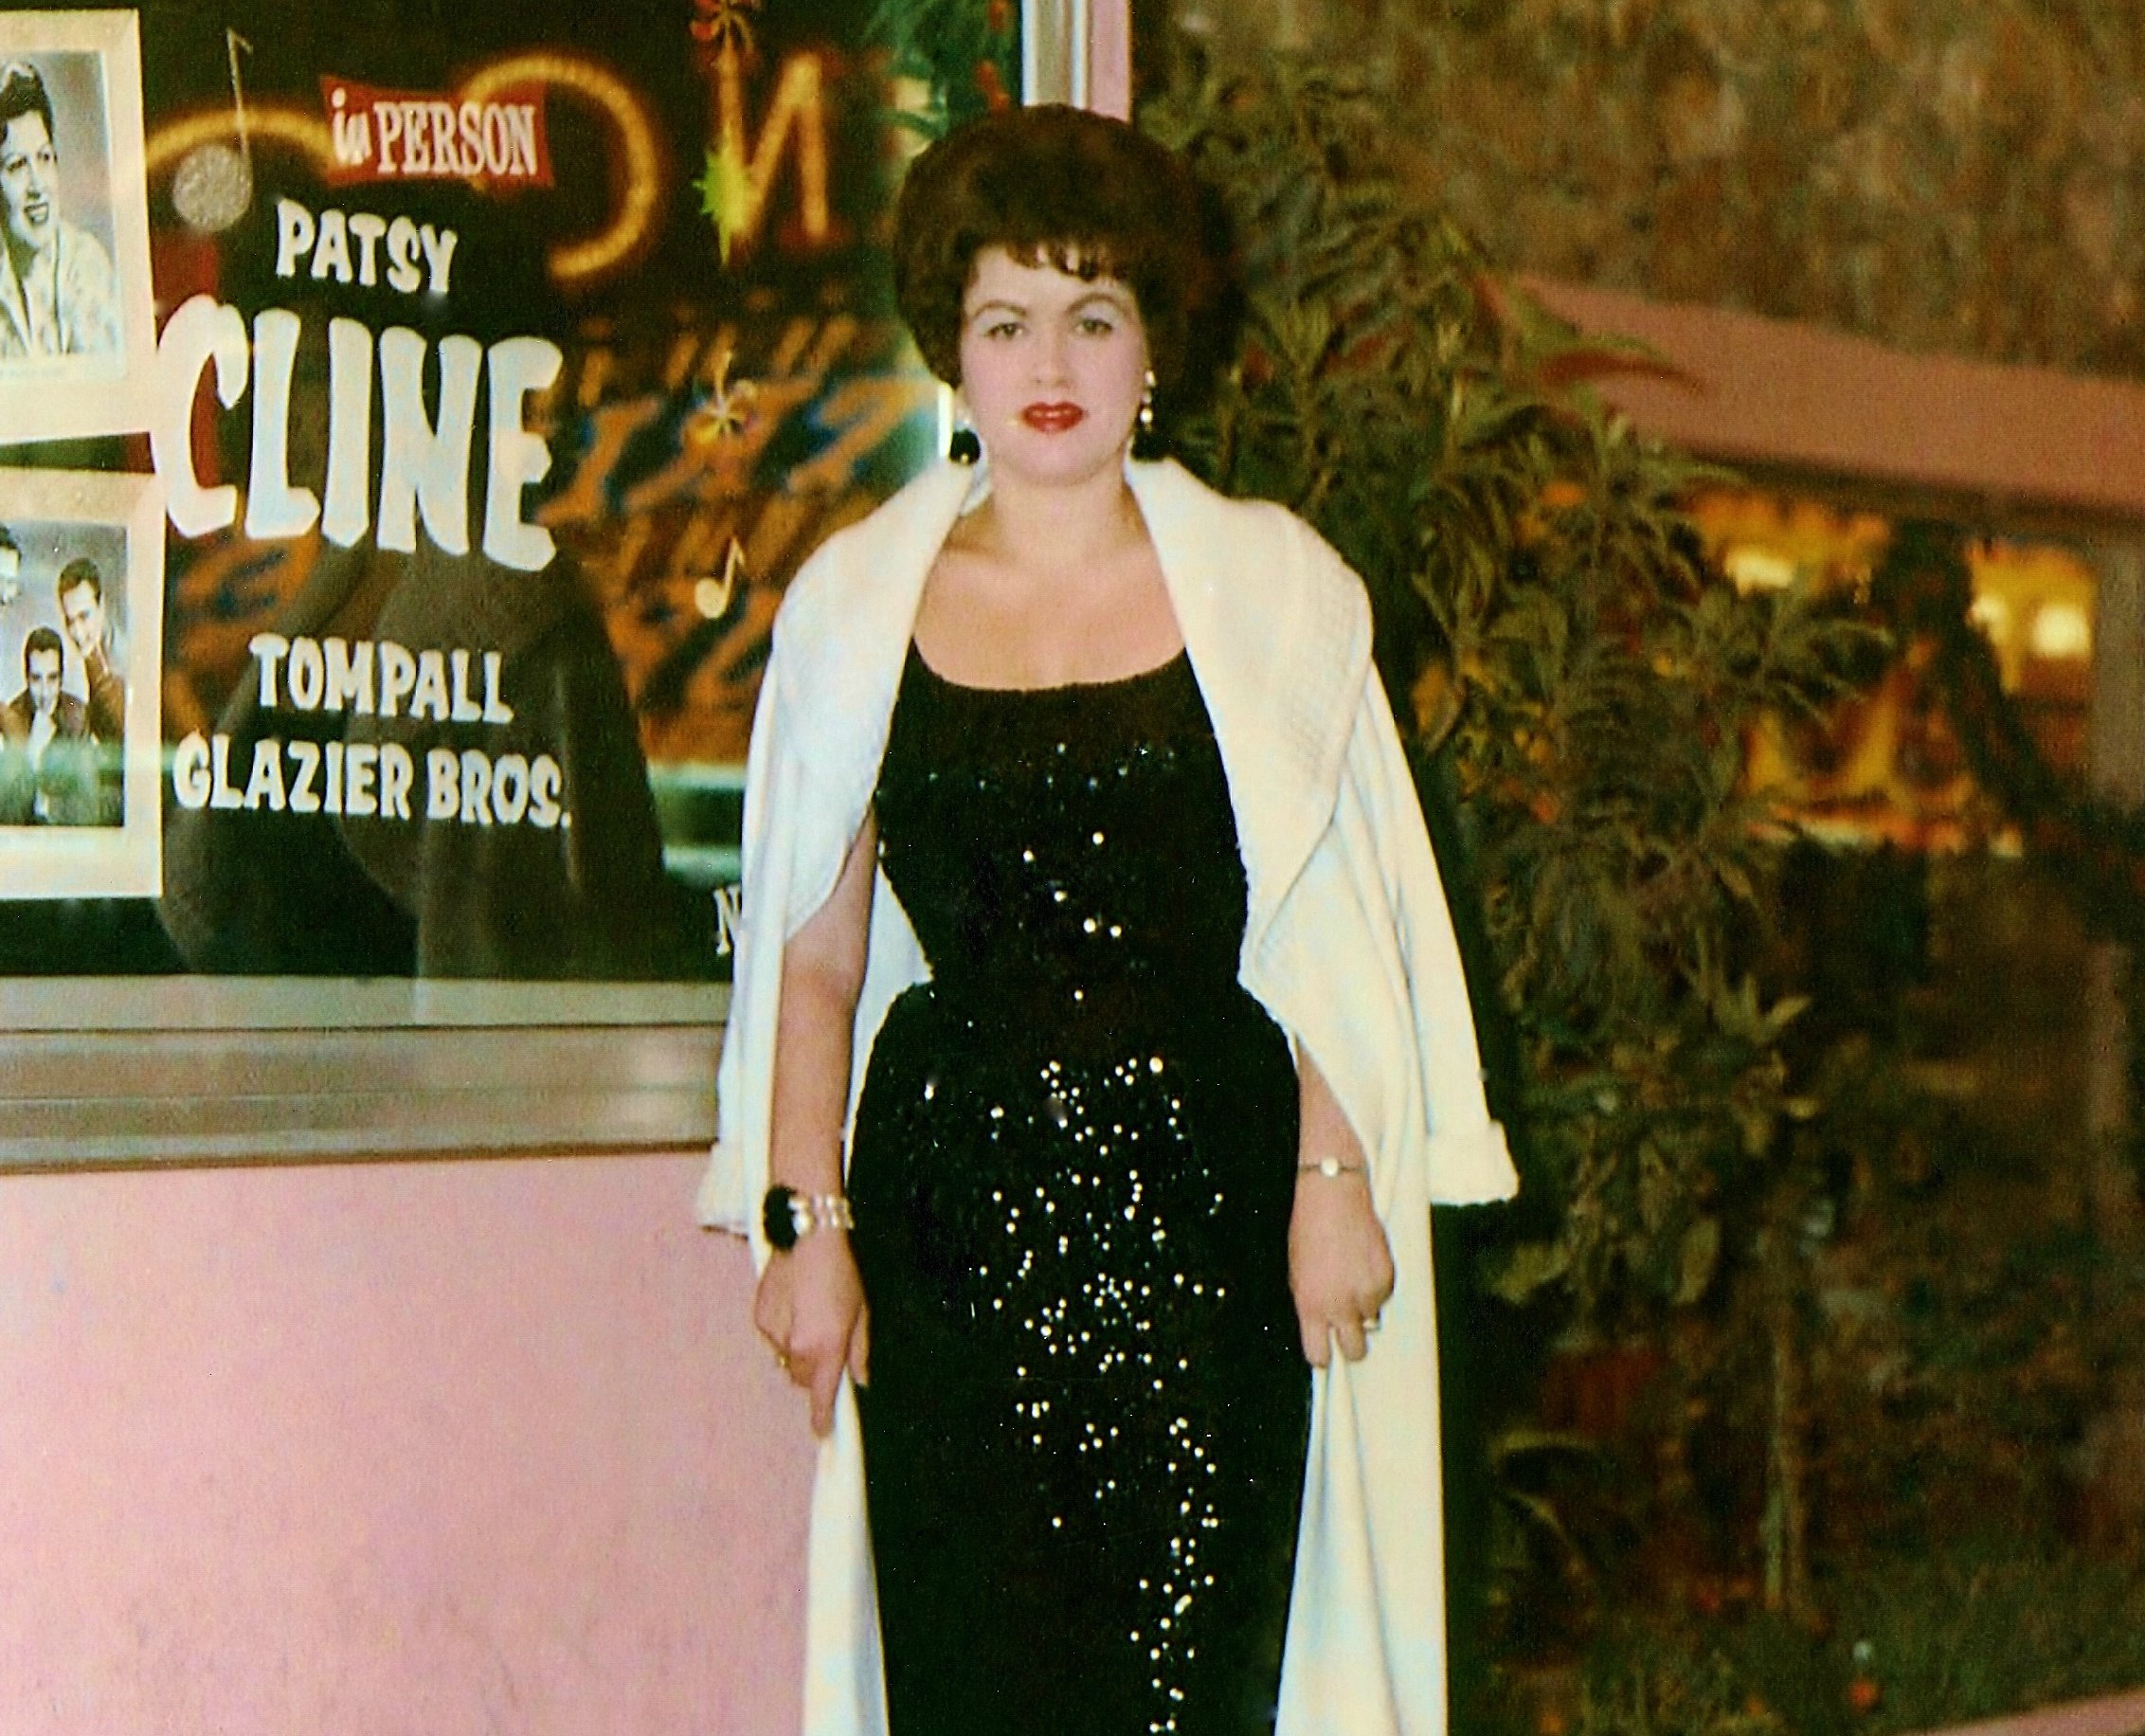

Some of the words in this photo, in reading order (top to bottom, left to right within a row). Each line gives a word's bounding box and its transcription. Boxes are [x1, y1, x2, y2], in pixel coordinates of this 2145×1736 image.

[374, 102, 536, 175] PERSON
[276, 198, 458, 294] PATSY
[155, 294, 564, 570] CLINE
[249, 633, 514, 724] TOMPALL
[173, 735, 412, 822] GLAZIER
[425, 747, 572, 829] BROS.
